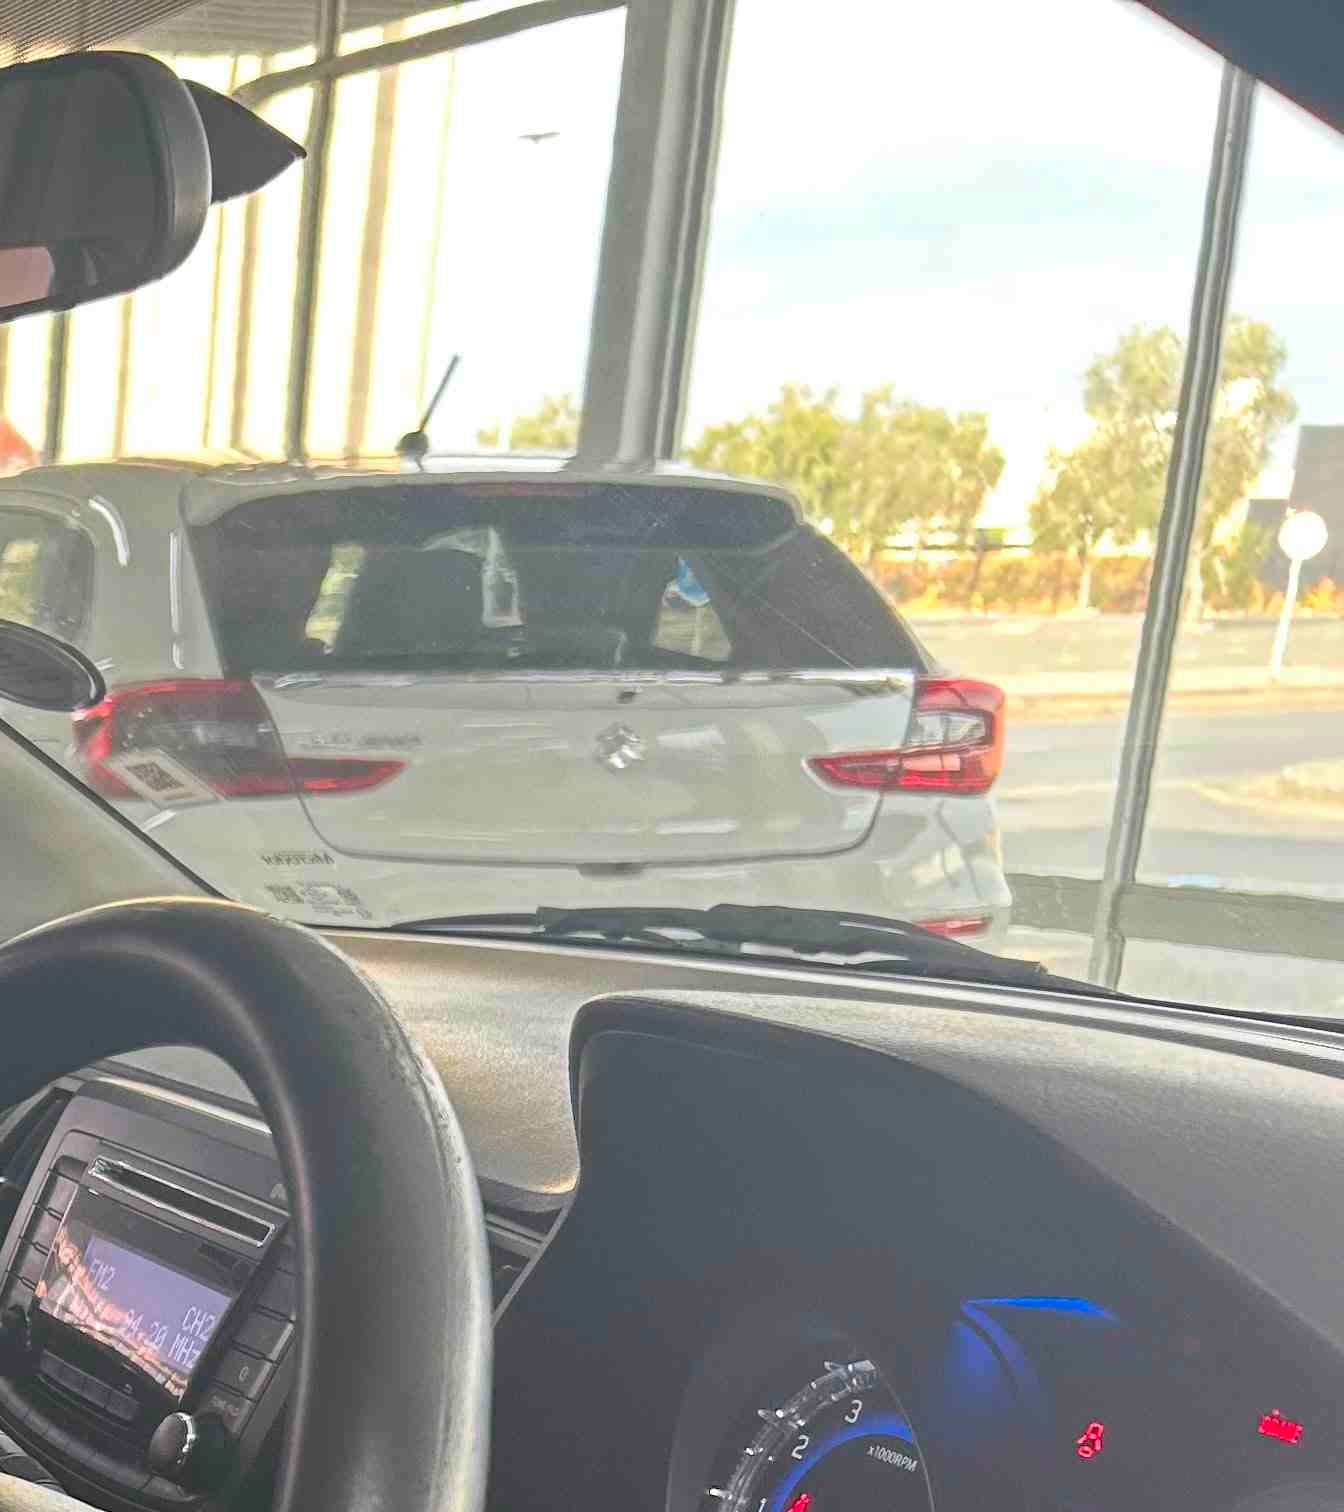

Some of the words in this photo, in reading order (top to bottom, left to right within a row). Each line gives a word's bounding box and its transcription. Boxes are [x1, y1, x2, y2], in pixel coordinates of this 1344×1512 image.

[181, 1305, 216, 1342] CH2
[844, 1399, 863, 1424] 3
[791, 1434, 809, 1460] 2
[867, 1445, 919, 1473] x1000RPM
